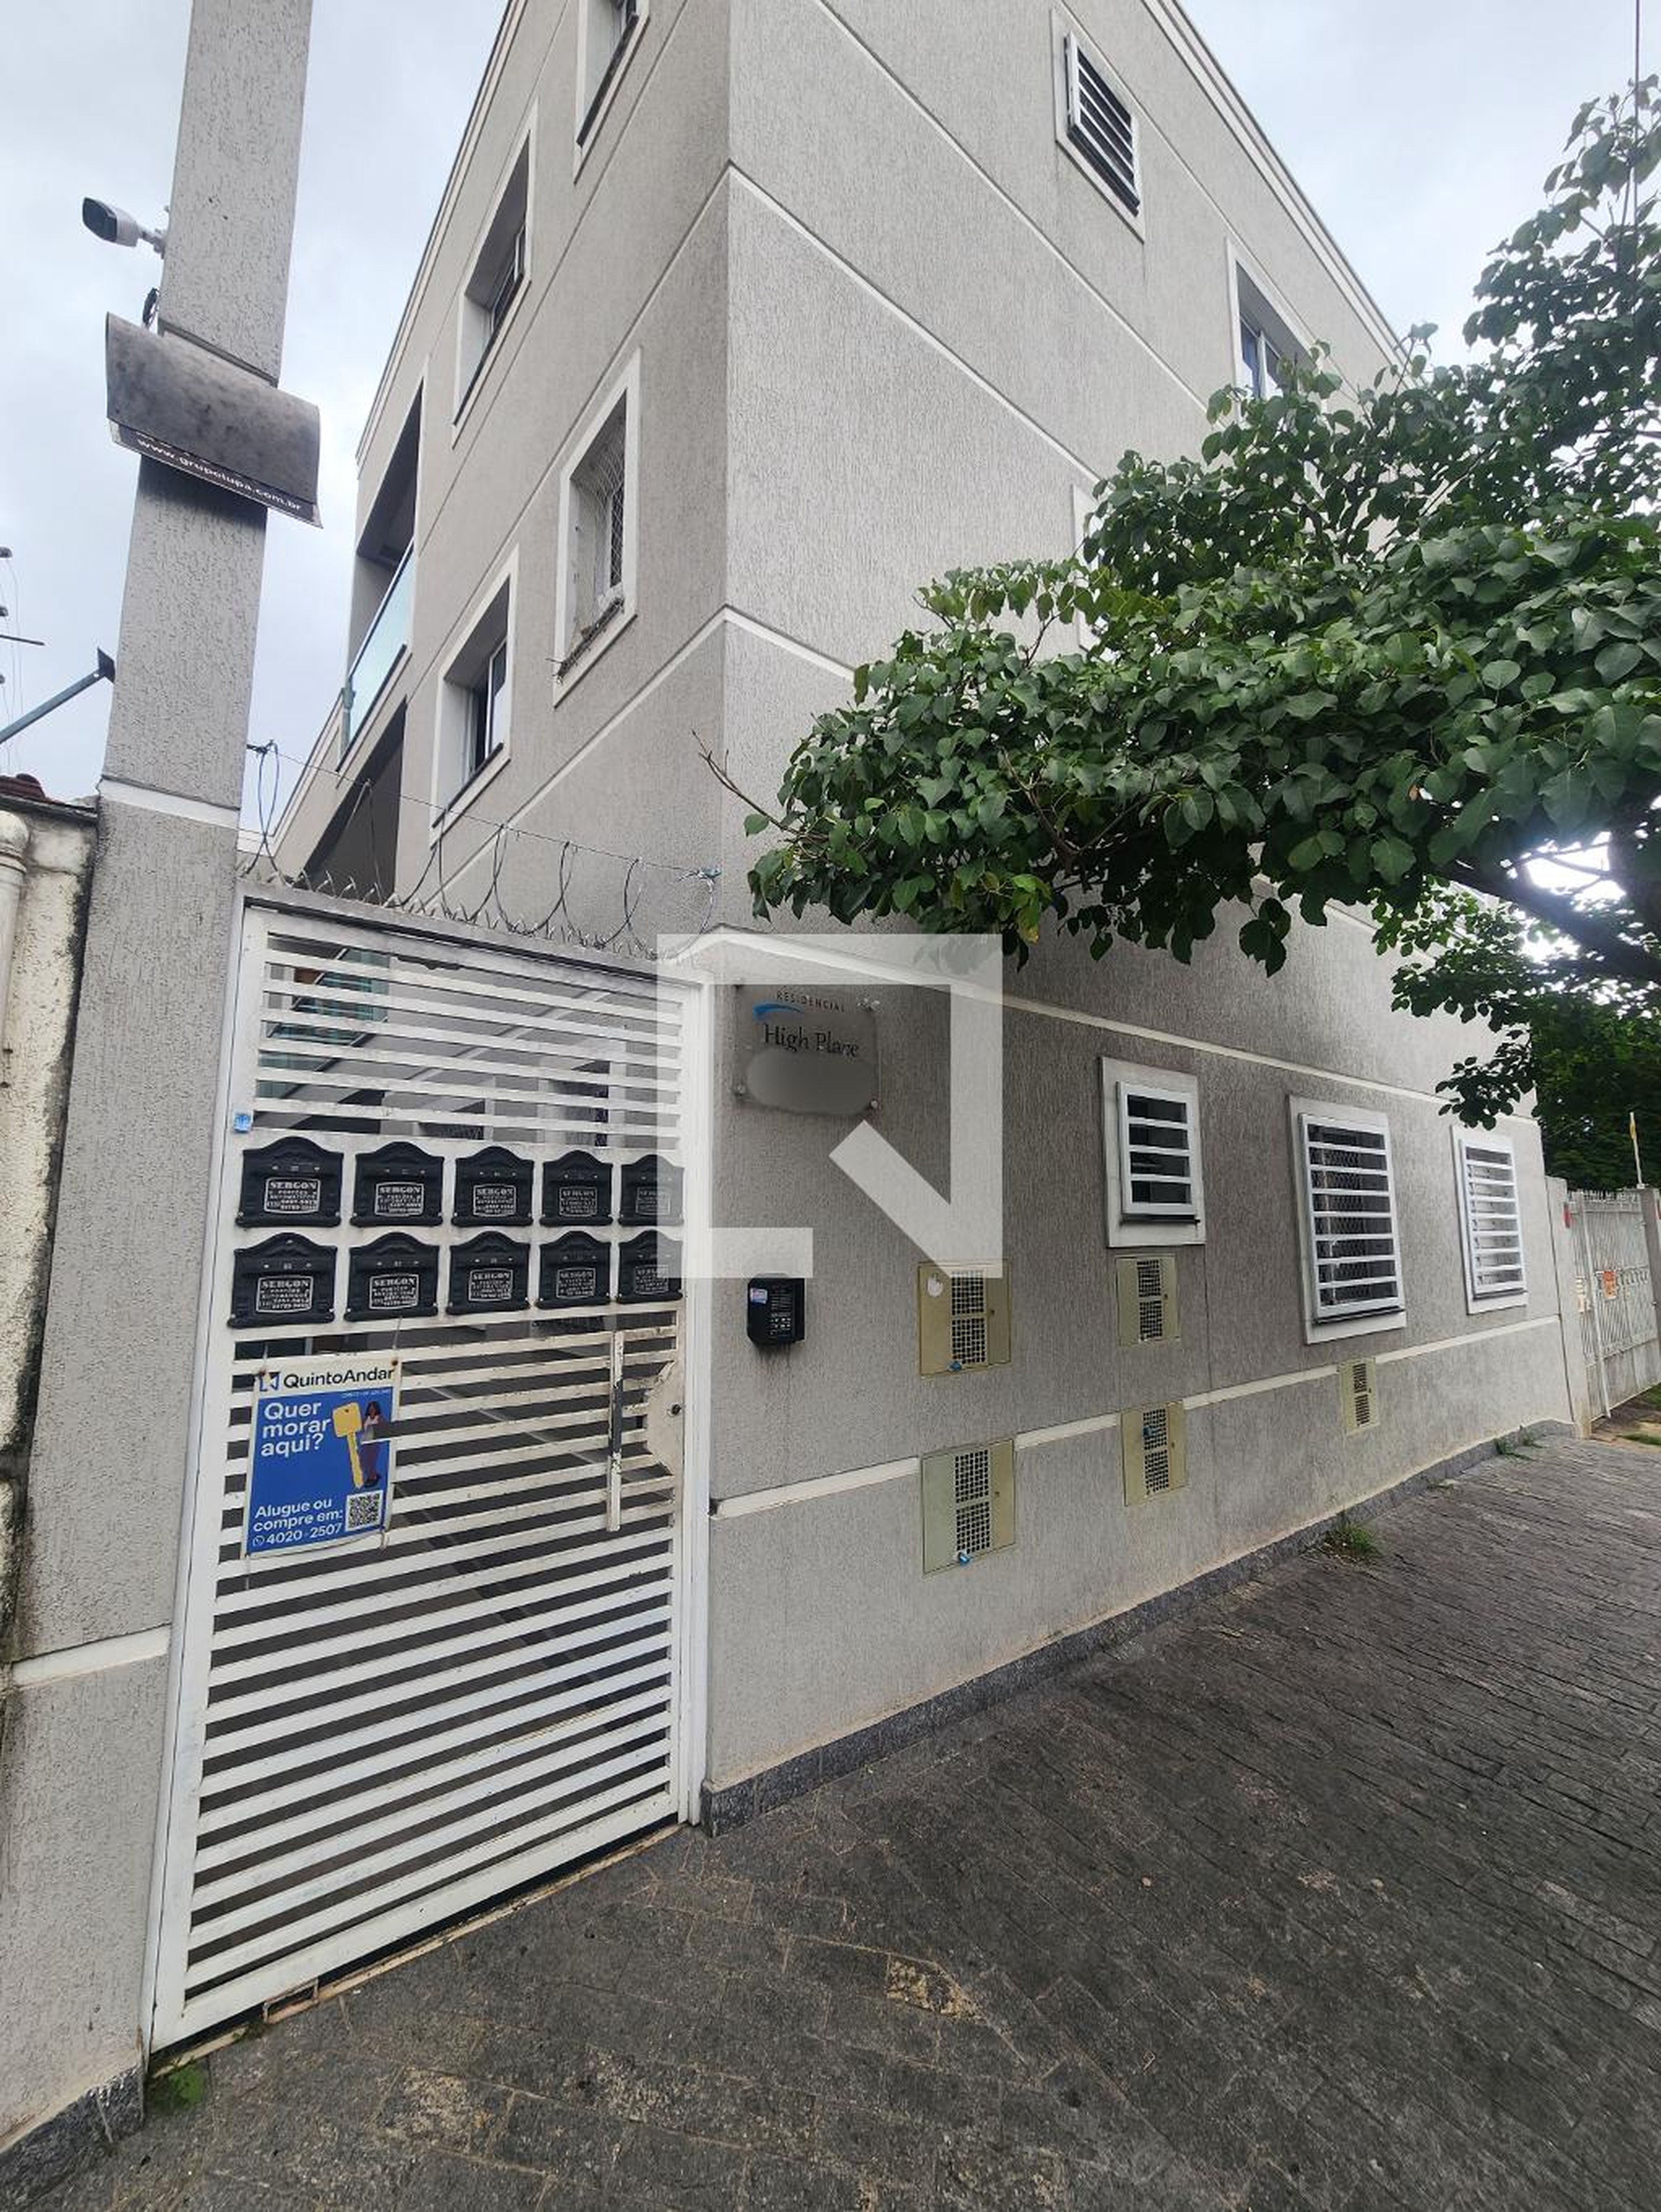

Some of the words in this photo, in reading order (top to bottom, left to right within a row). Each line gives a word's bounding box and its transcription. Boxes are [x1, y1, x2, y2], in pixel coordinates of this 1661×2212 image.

[777, 990, 845, 1013] RESIDENCIAL
[763, 1023, 809, 1052] High
[283, 1367, 394, 1388] QuintoAndar
[264, 1402, 322, 1420] Quer
[262, 1418, 331, 1439] morar
[260, 1433, 324, 1457] aqui?
[254, 1501, 311, 1518] Alugue
[313, 1498, 332, 1510] ou
[253, 1514, 314, 1532] compre
[316, 1509, 343, 1522] em:
[266, 1530, 303, 1545] 4020
[310, 1522, 343, 1538] 2507
